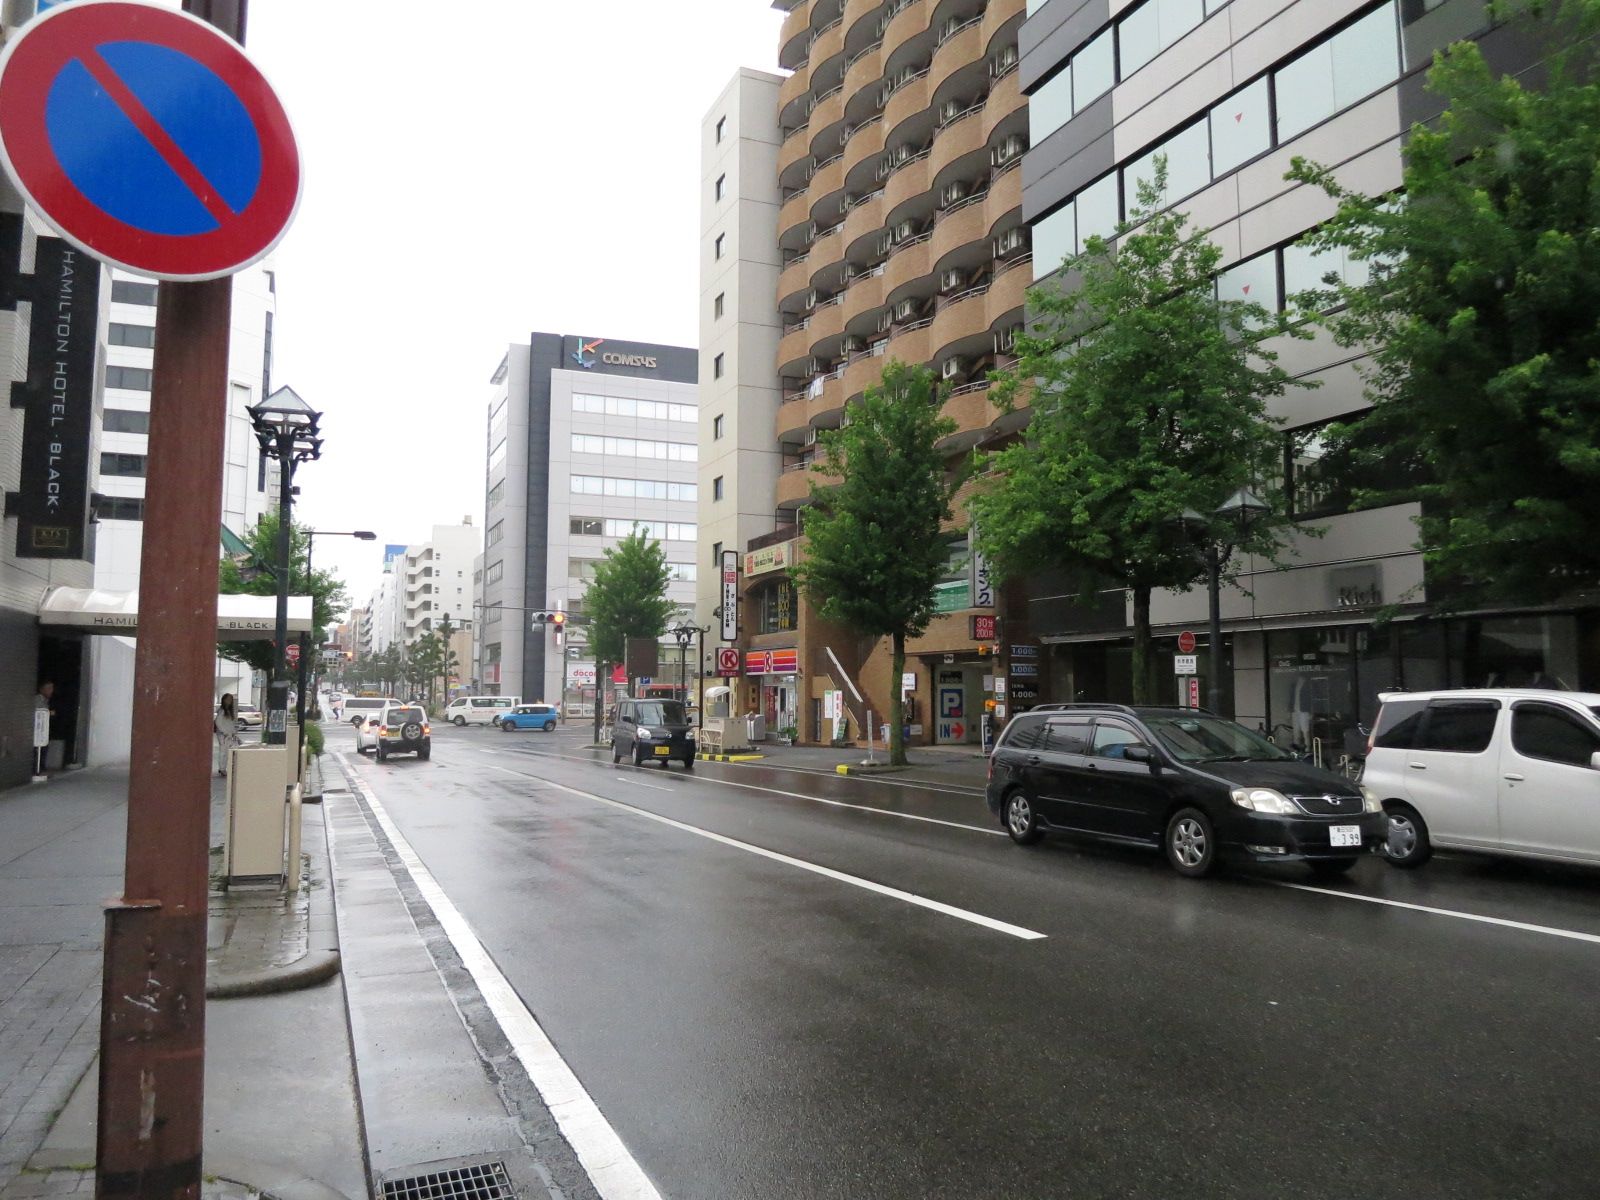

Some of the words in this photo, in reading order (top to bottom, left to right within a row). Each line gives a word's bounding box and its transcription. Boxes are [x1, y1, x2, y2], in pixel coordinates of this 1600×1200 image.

[56, 250, 76, 352] HAMILTON
[602, 352, 657, 368] COMSYS
[50, 362, 68, 427] HOTEL
[94, 616, 138, 626] HAMIL
[573, 669, 596, 677] doco
[943, 693, 960, 715] P
[939, 723, 951, 738] IN
